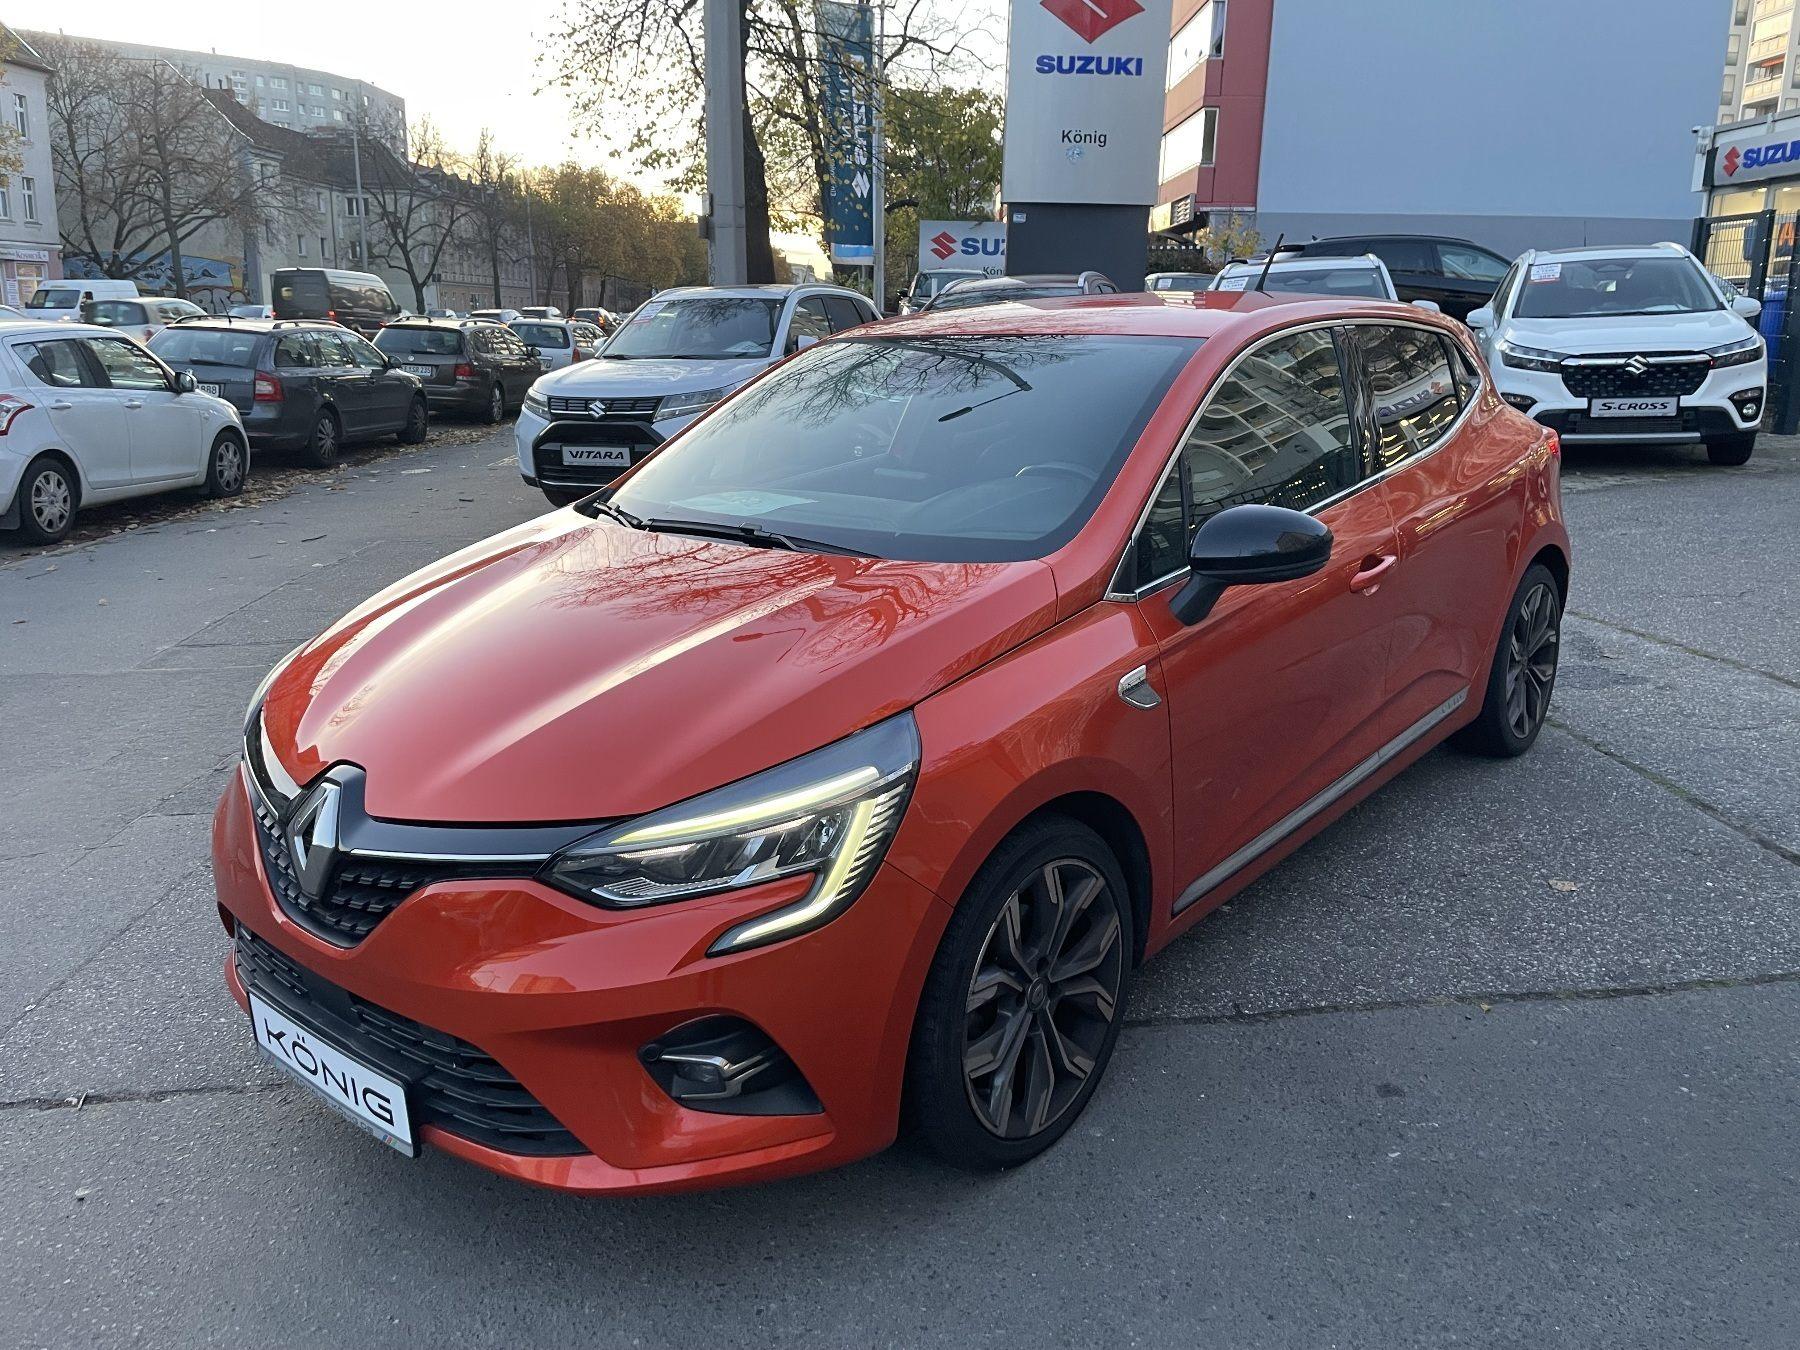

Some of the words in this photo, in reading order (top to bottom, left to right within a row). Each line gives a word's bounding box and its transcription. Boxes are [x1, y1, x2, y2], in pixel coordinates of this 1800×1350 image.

[1035, 55, 1143, 76] SUZUKI
[1061, 129, 1107, 148] König
[568, 450, 624, 460] VITARA
[264, 1017, 395, 1127] KÖNIG
